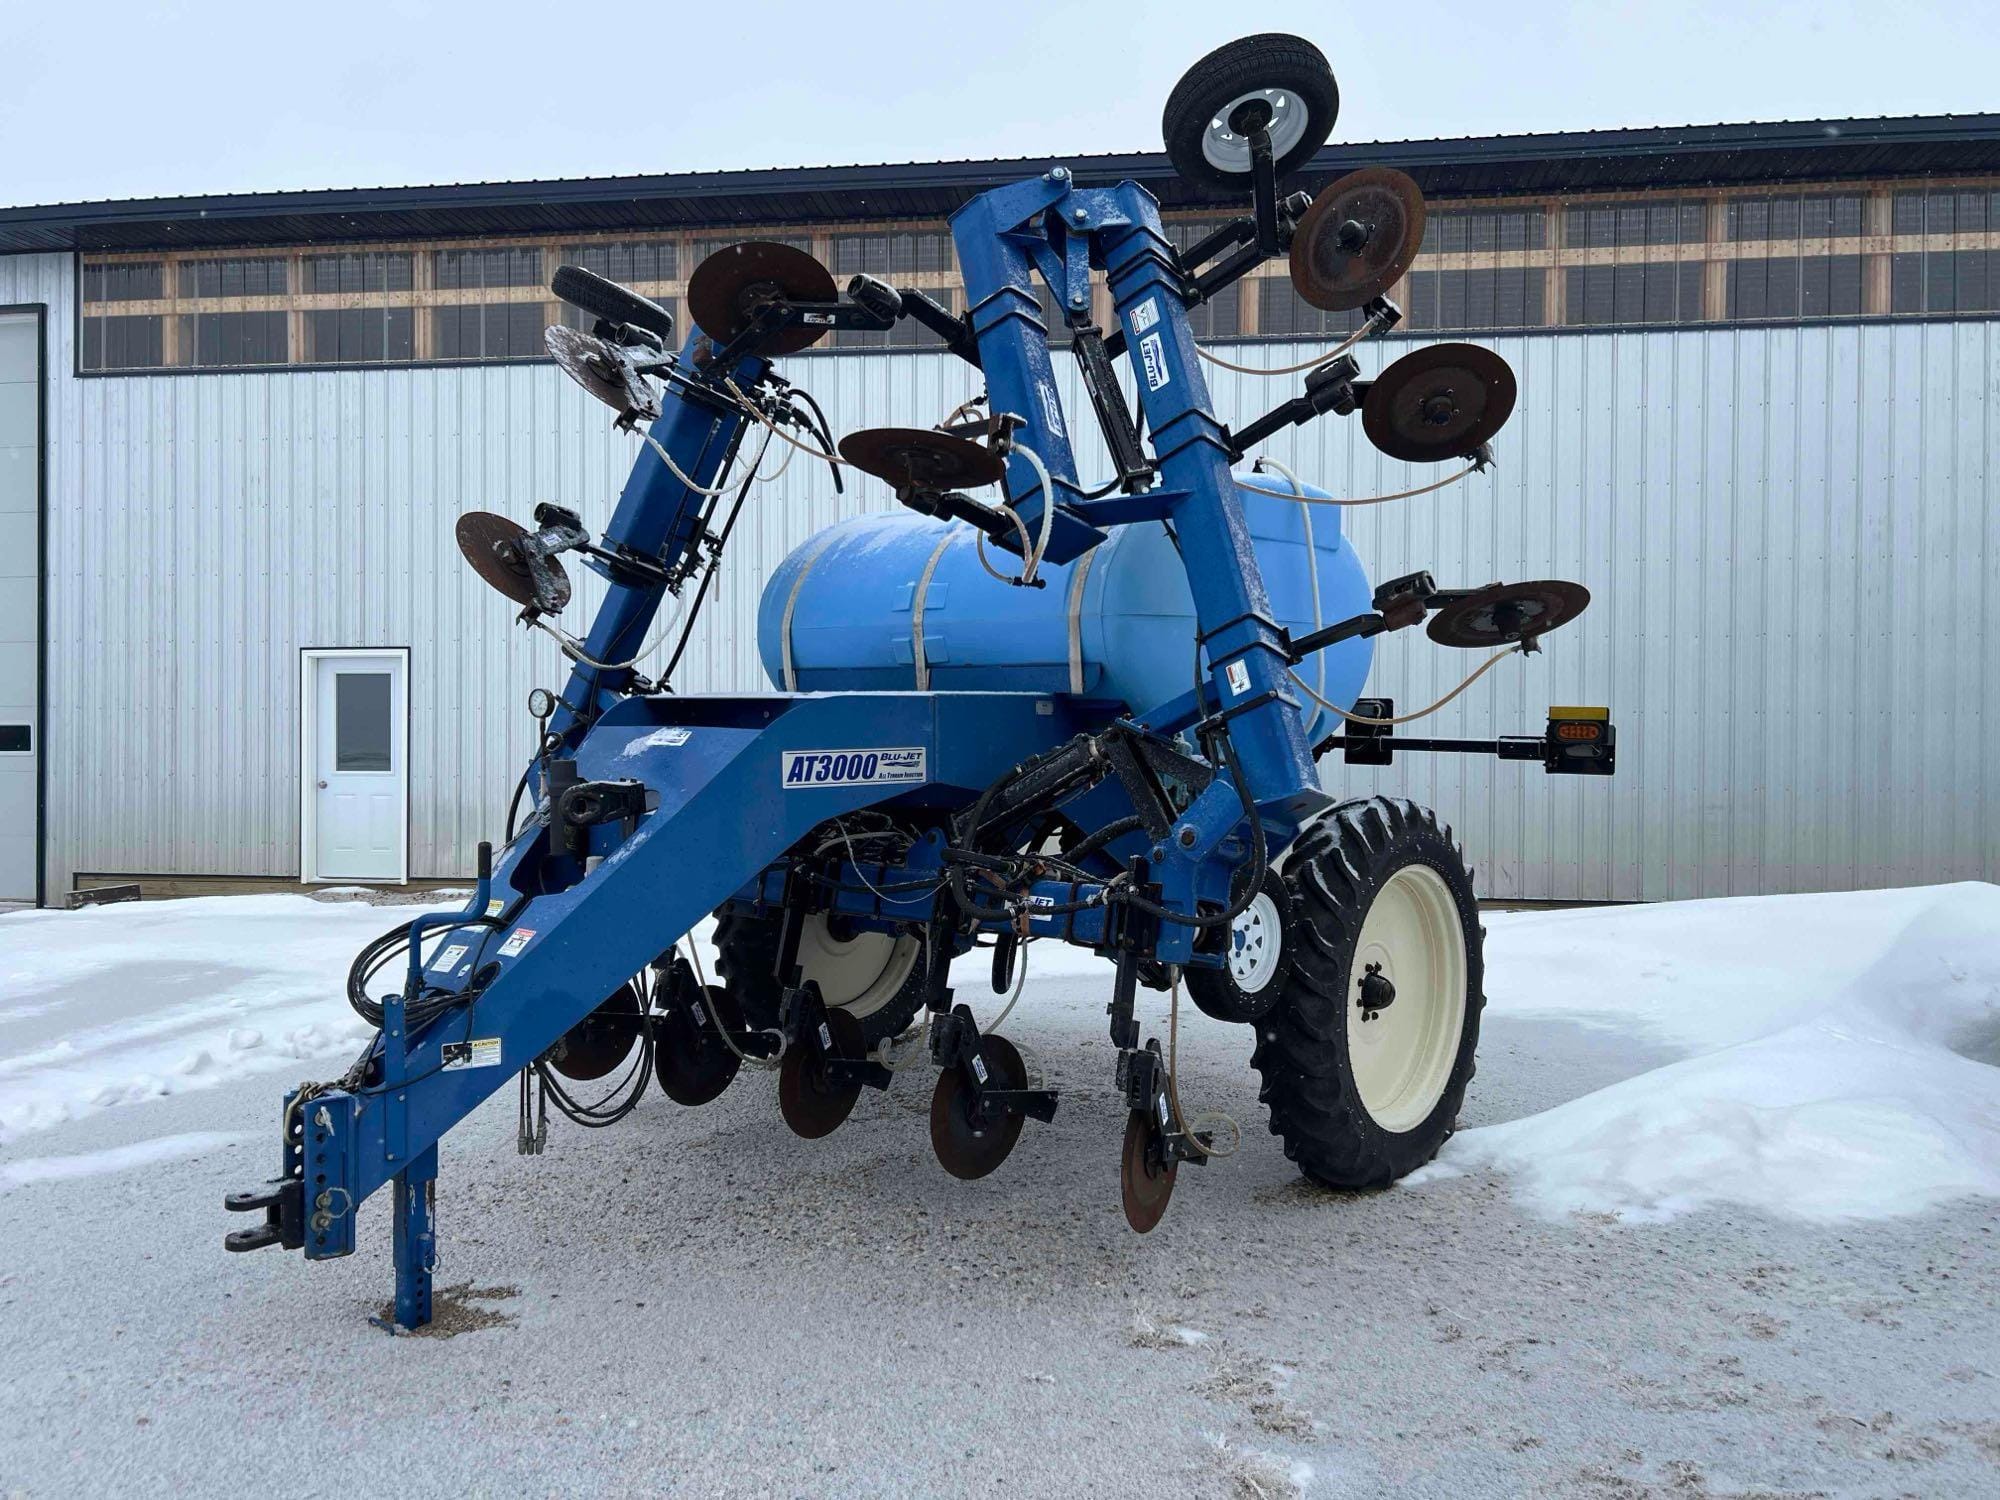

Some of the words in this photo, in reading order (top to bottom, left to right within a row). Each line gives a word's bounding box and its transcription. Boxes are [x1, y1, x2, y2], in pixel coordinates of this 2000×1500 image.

[1141, 342, 1158, 388] BLU-JET
[786, 753, 879, 783] AT3000
[880, 752, 923, 761] BLU-JET
